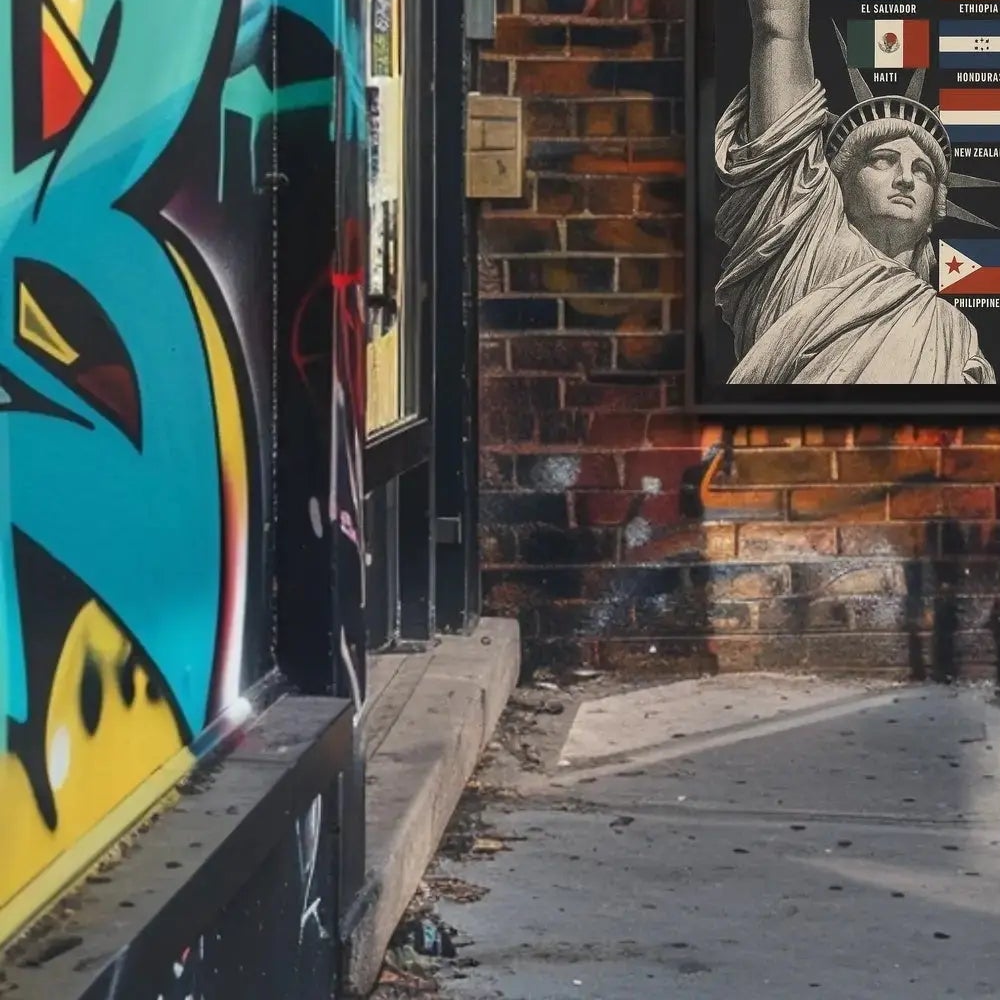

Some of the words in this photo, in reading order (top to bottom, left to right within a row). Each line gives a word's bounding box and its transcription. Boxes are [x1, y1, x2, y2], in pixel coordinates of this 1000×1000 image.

[861, 3, 871, 14] EL
[873, 3, 917, 14] SALVADOR
[959, 3, 999, 14] ETHIOPIA
[873, 72, 897, 83] HAITI
[954, 147, 972, 158] NEW
